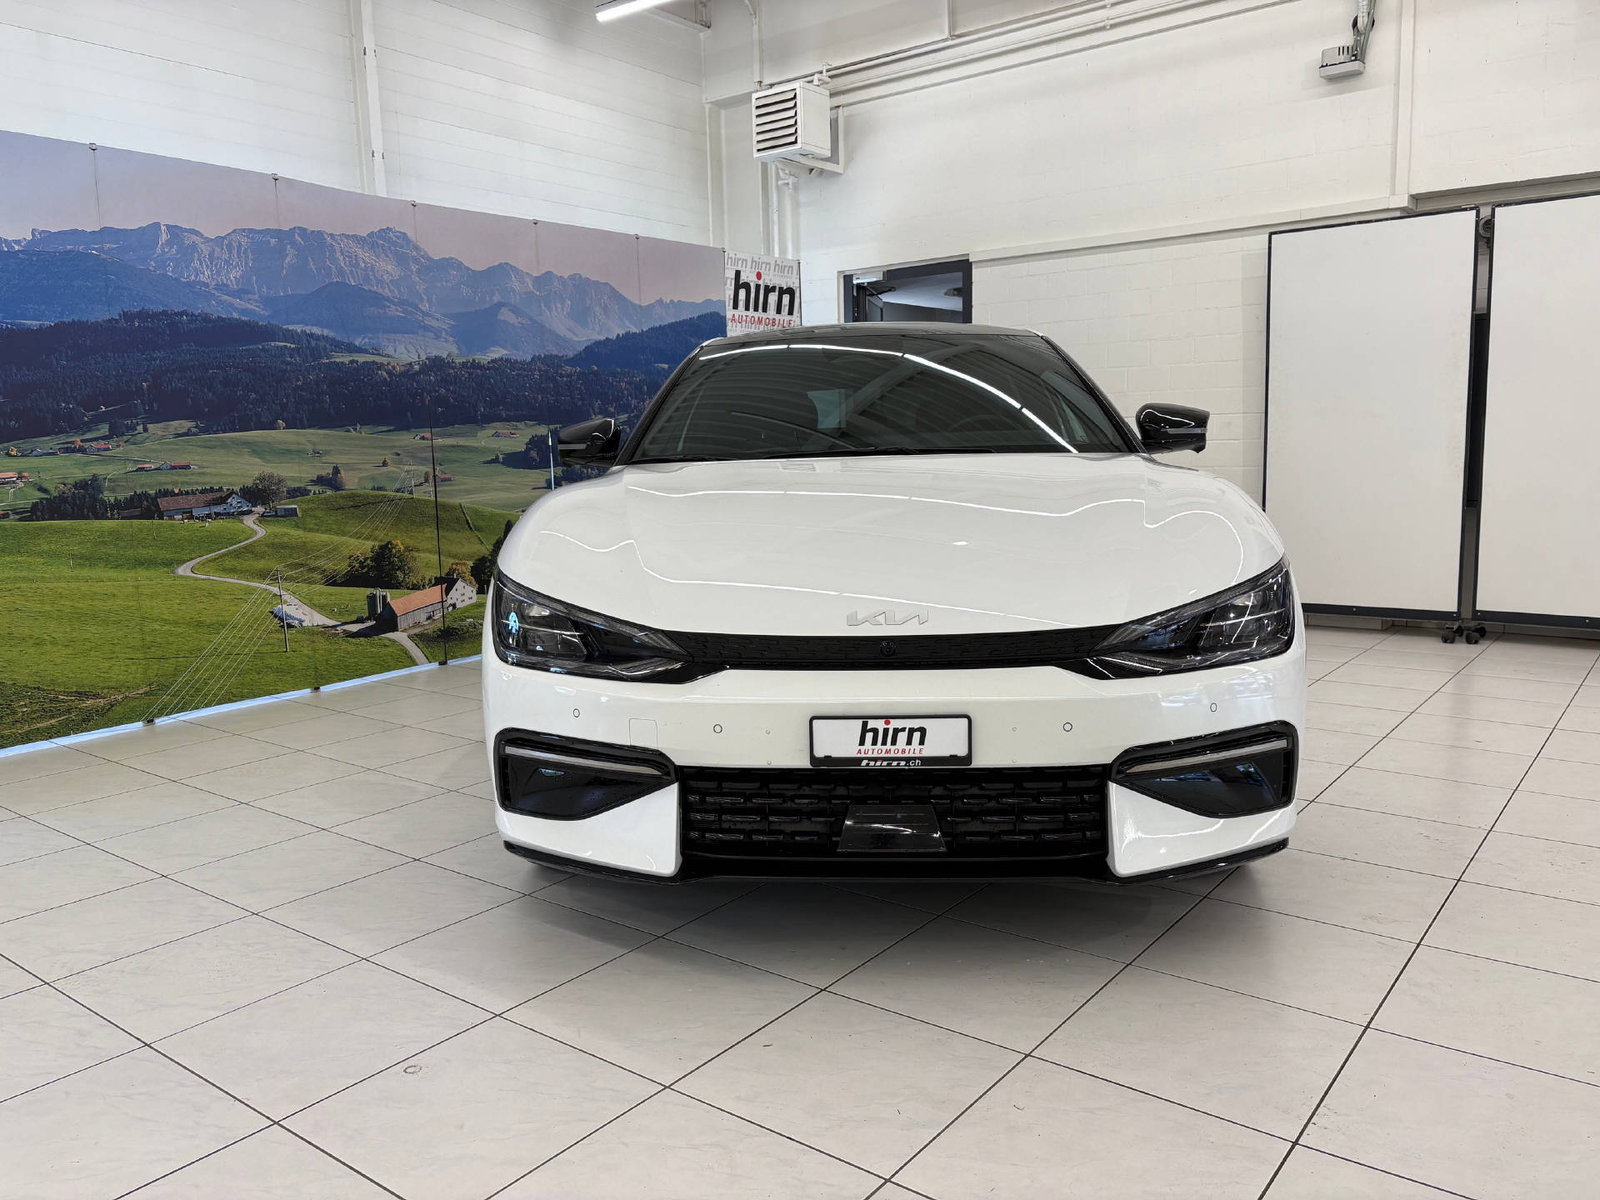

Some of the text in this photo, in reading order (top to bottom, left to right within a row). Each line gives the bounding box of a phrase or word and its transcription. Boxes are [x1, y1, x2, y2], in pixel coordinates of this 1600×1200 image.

[726, 253, 794, 276] hirn hirn hirn
[732, 269, 796, 316] hirn
[730, 313, 793, 329] AUTOMOBILE
[858, 719, 927, 747] hirn
[856, 747, 924, 756] AUTOMOBILE
[860, 759, 922, 767] hirn.ch
